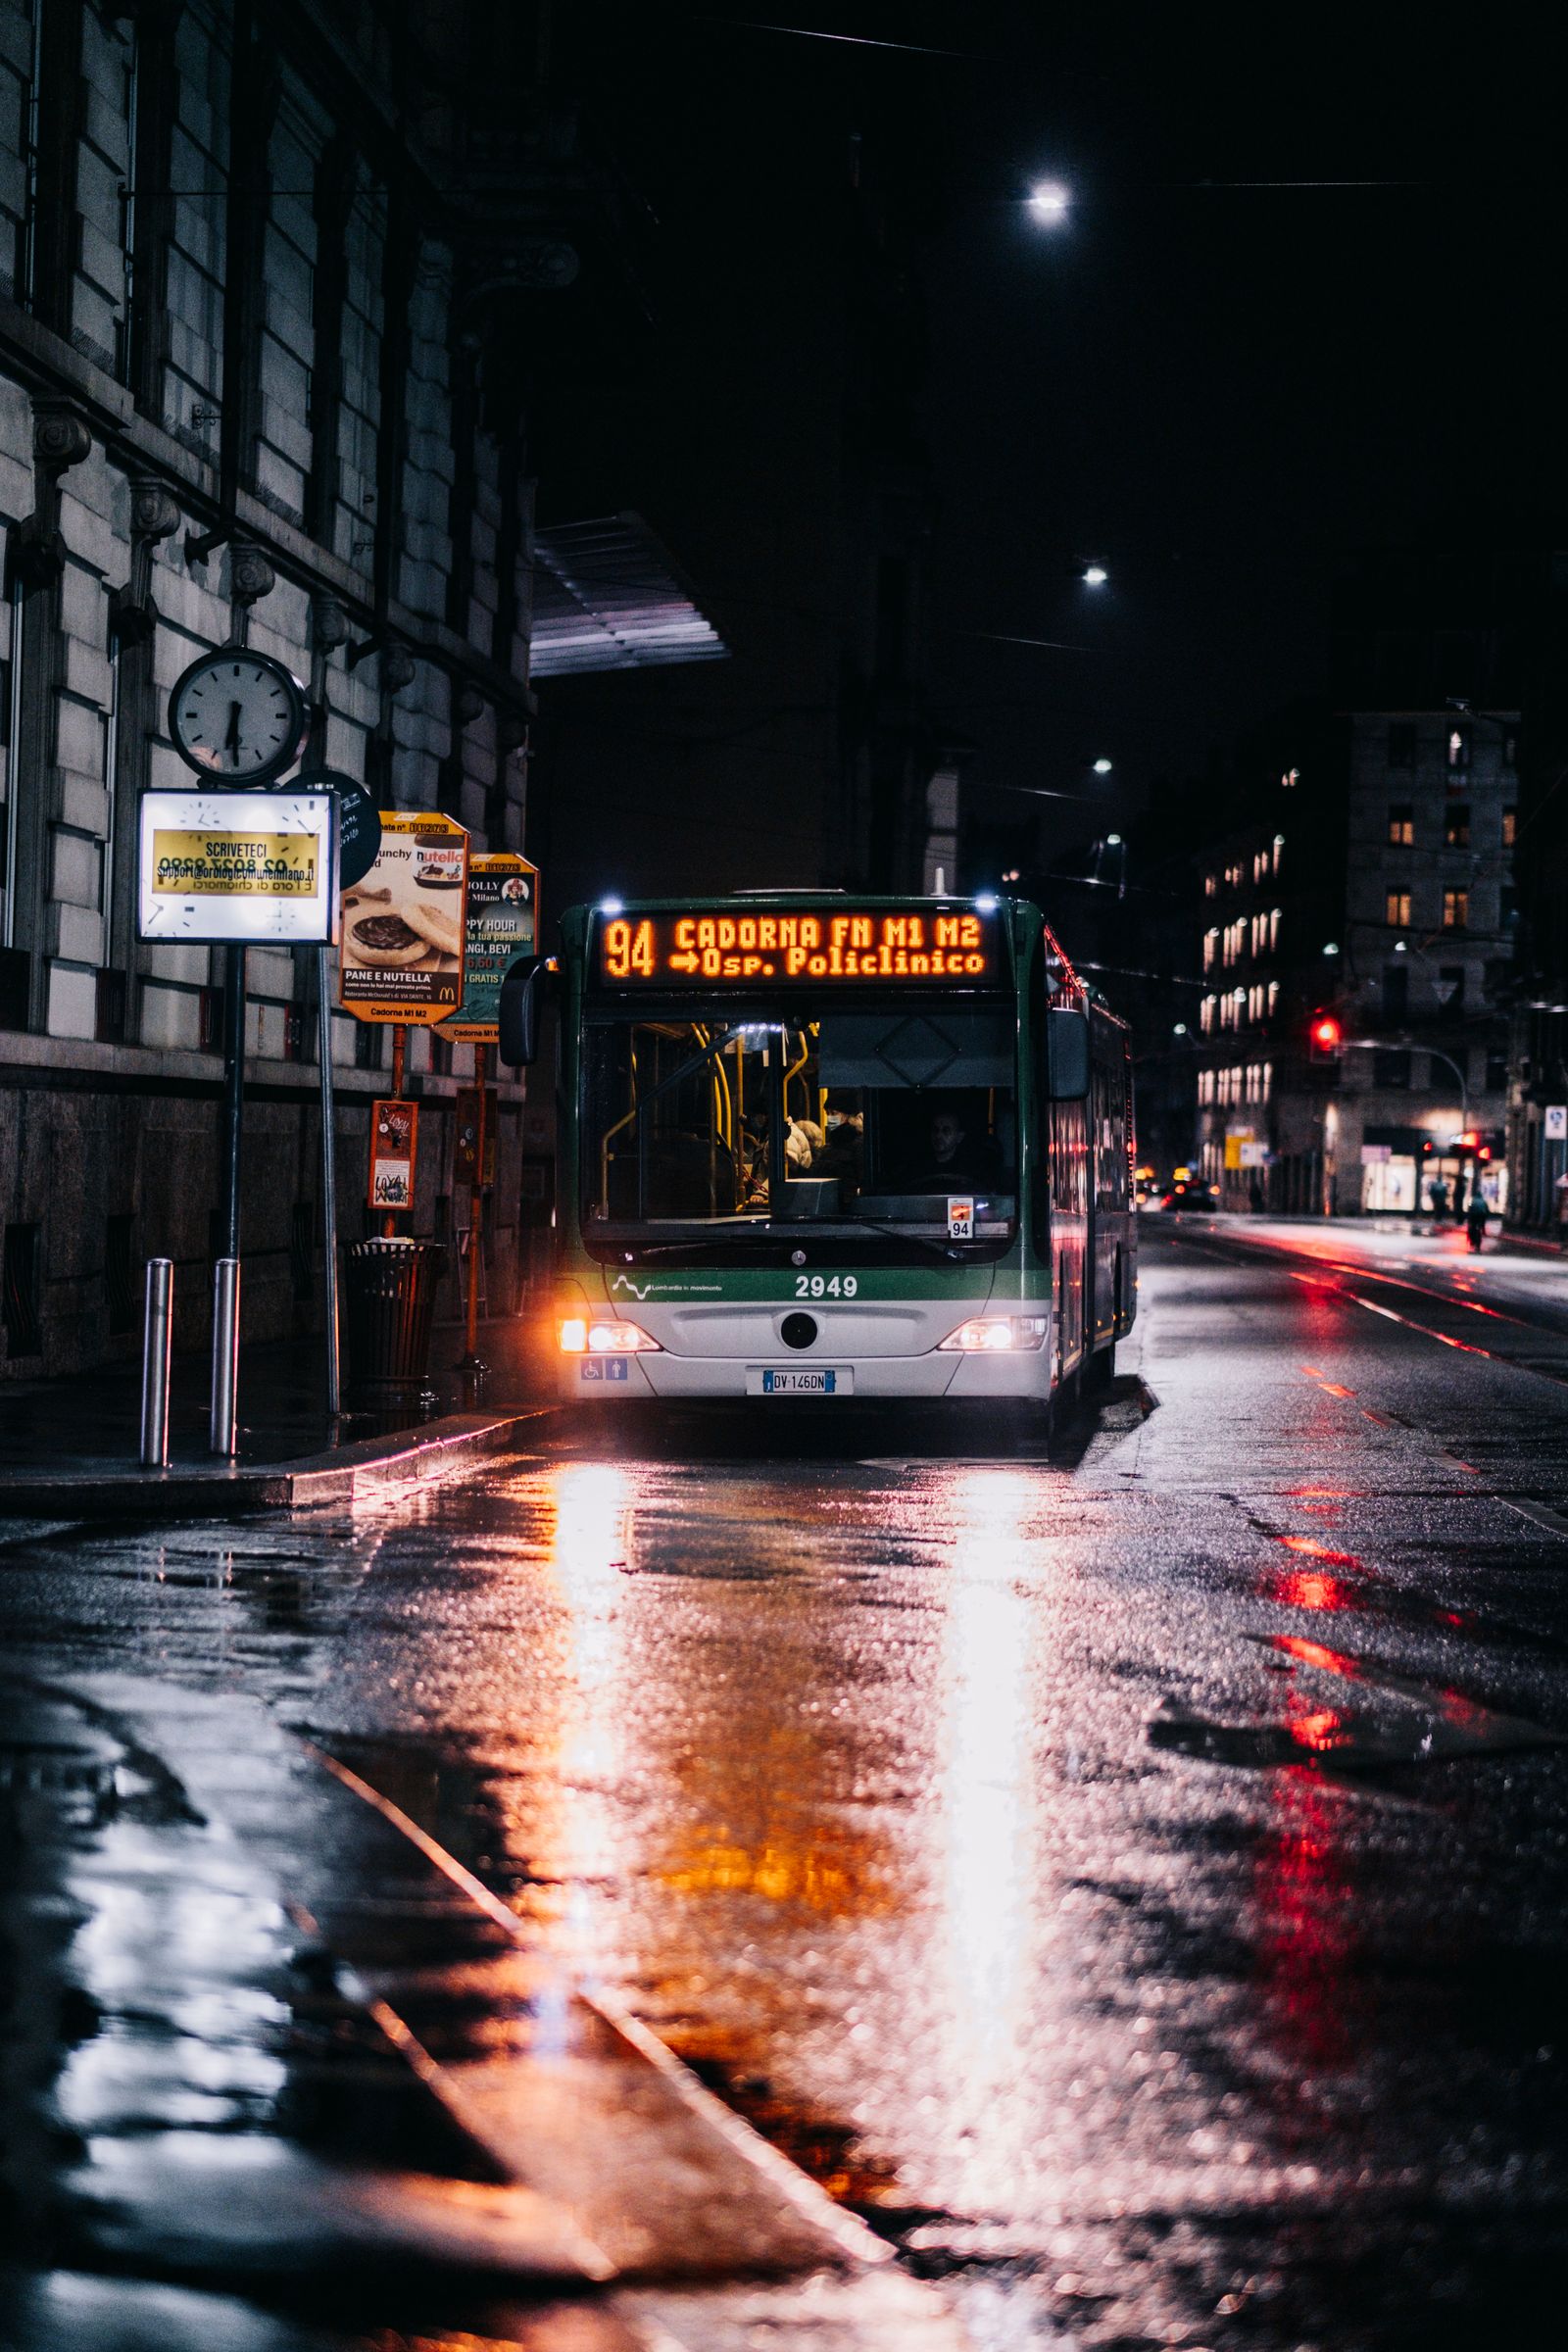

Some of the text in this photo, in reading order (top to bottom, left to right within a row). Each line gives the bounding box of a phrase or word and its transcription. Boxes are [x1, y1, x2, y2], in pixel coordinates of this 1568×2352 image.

[206, 842, 267, 858] SCRIVETECI
[378, 849, 412, 860] unchy
[416, 850, 464, 862] nutella
[472, 893, 500, 902] Milano
[487, 919, 516, 931] HOUR
[493, 933, 531, 942] passione
[489, 944, 511, 954] BEVI
[607, 916, 980, 976] 94 CADORNA FN M1 M2
[703, 946, 984, 976] Osp. Policlinico
[345, 970, 373, 980] PANE
[374, 971, 381, 981] E
[469, 974, 498, 983] GRATIS
[370, 1008, 403, 1017] Cadorna
[953, 1222, 969, 1236] 94
[795, 1276, 858, 1298] 2949
